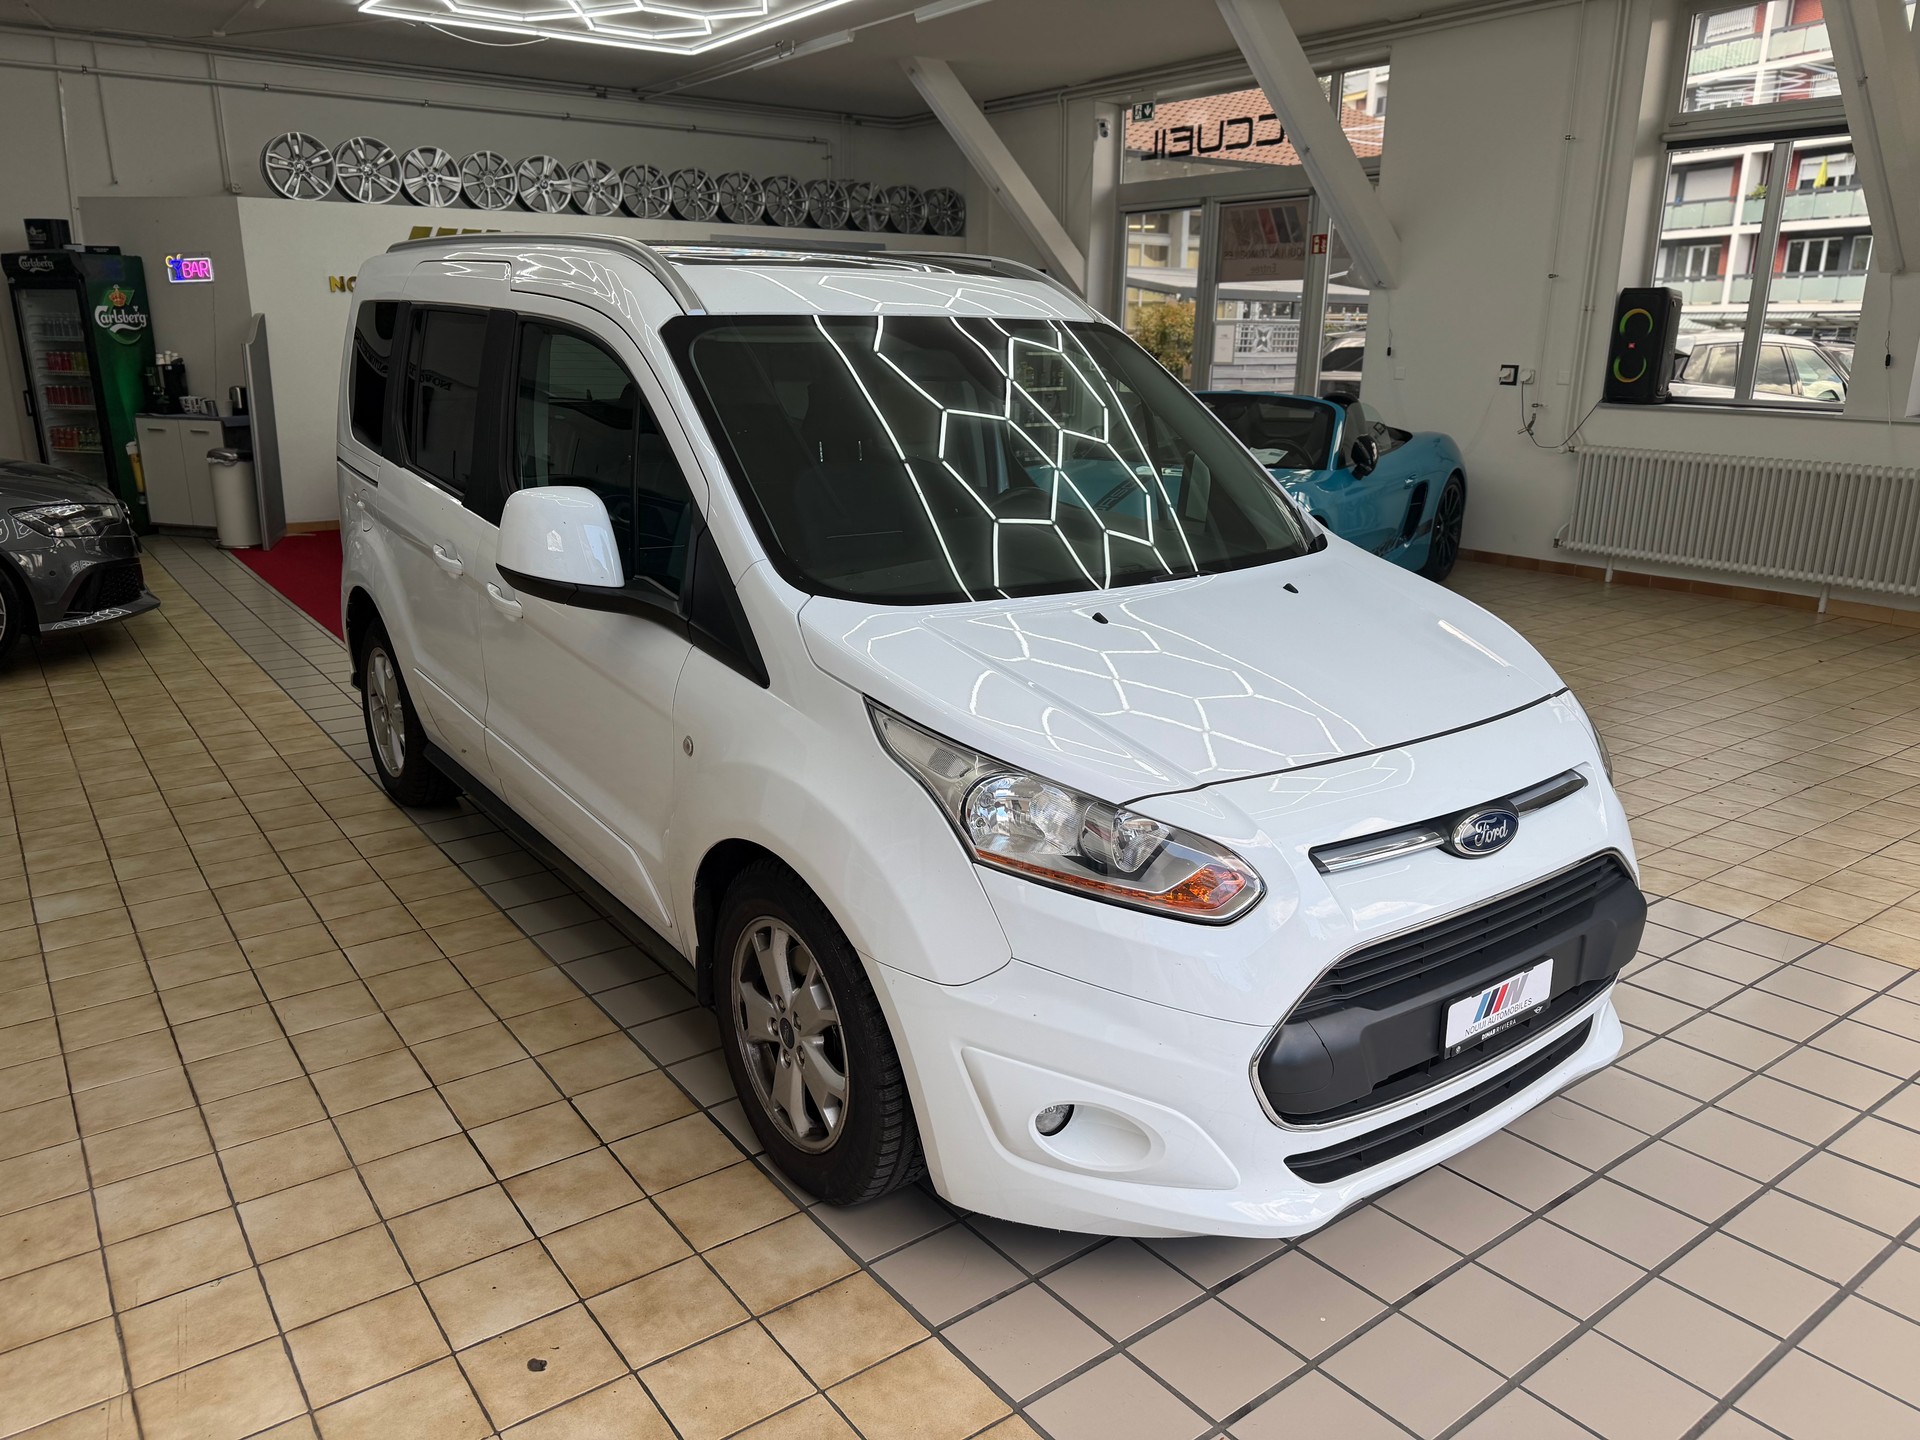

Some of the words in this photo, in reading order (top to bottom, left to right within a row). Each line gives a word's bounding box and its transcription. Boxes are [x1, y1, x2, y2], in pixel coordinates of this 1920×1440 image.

[18, 255, 54, 273] Carlsberg
[182, 260, 210, 279] BAR
[95, 305, 148, 333] Carlsberg
[1474, 816, 1508, 847] Ford
[1487, 997, 1533, 1025] AUTOMOBILES
[1496, 1019, 1517, 1033] RIVIERA
